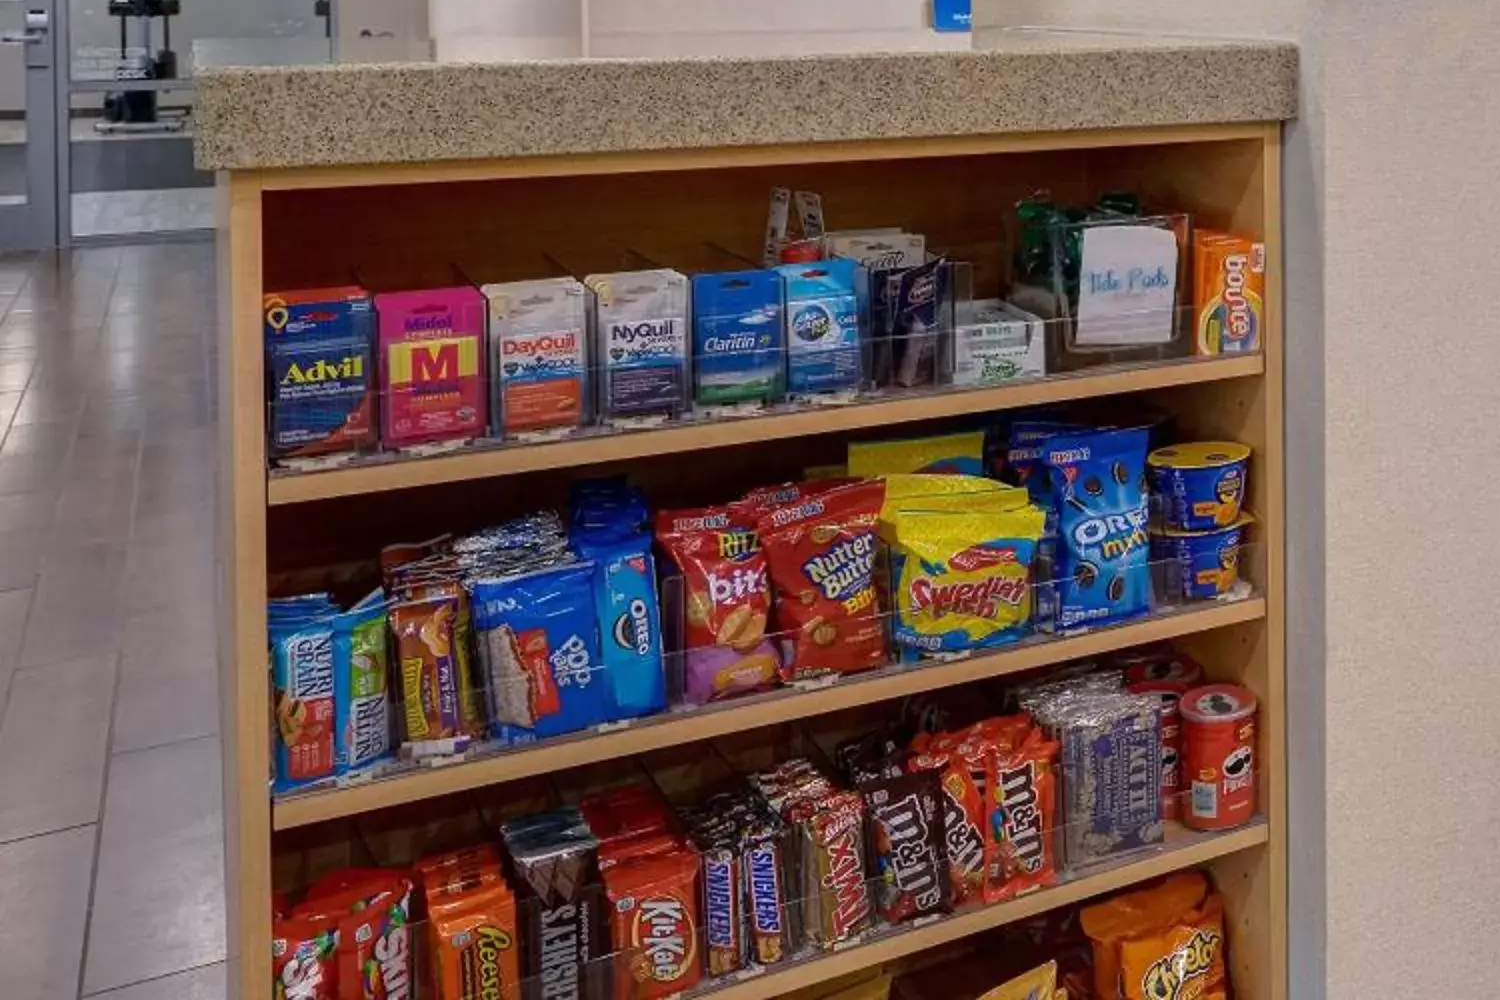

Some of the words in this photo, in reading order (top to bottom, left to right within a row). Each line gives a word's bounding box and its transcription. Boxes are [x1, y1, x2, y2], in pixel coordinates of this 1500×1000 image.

[503, 333, 576, 356] DayQuil
[611, 319, 673, 343] NyQuil
[280, 355, 364, 385] Advil
[718, 532, 761, 559] RITZ
[630, 599, 650, 656] OREO
[708, 862, 733, 946] SNICKERS
[751, 850, 780, 932] SNICKERS
